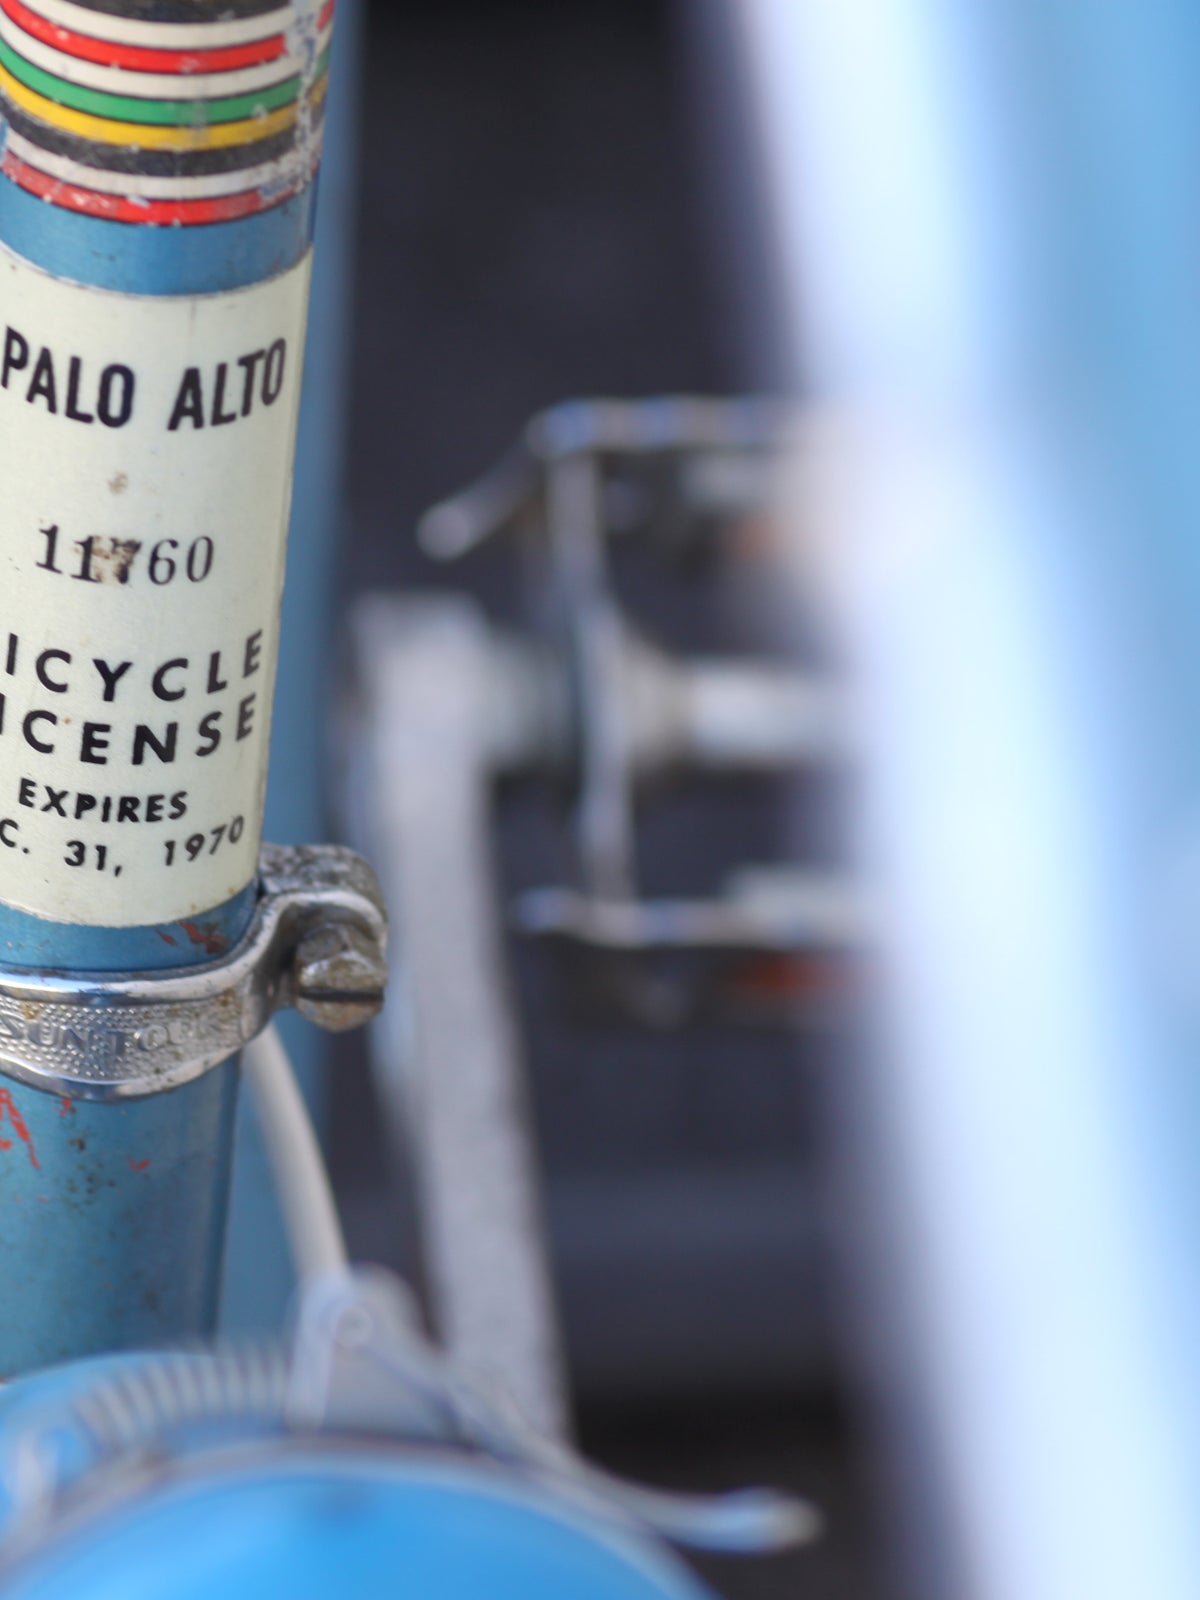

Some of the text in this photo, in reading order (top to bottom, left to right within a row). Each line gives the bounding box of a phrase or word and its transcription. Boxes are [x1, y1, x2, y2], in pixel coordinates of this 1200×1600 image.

[0, 326, 287, 431] PALO ALTO
[35, 525, 214, 585] 11760
[18, 777, 189, 823] EXPIRES
[64, 841, 123, 877] 31,
[163, 815, 245, 867] 1970
